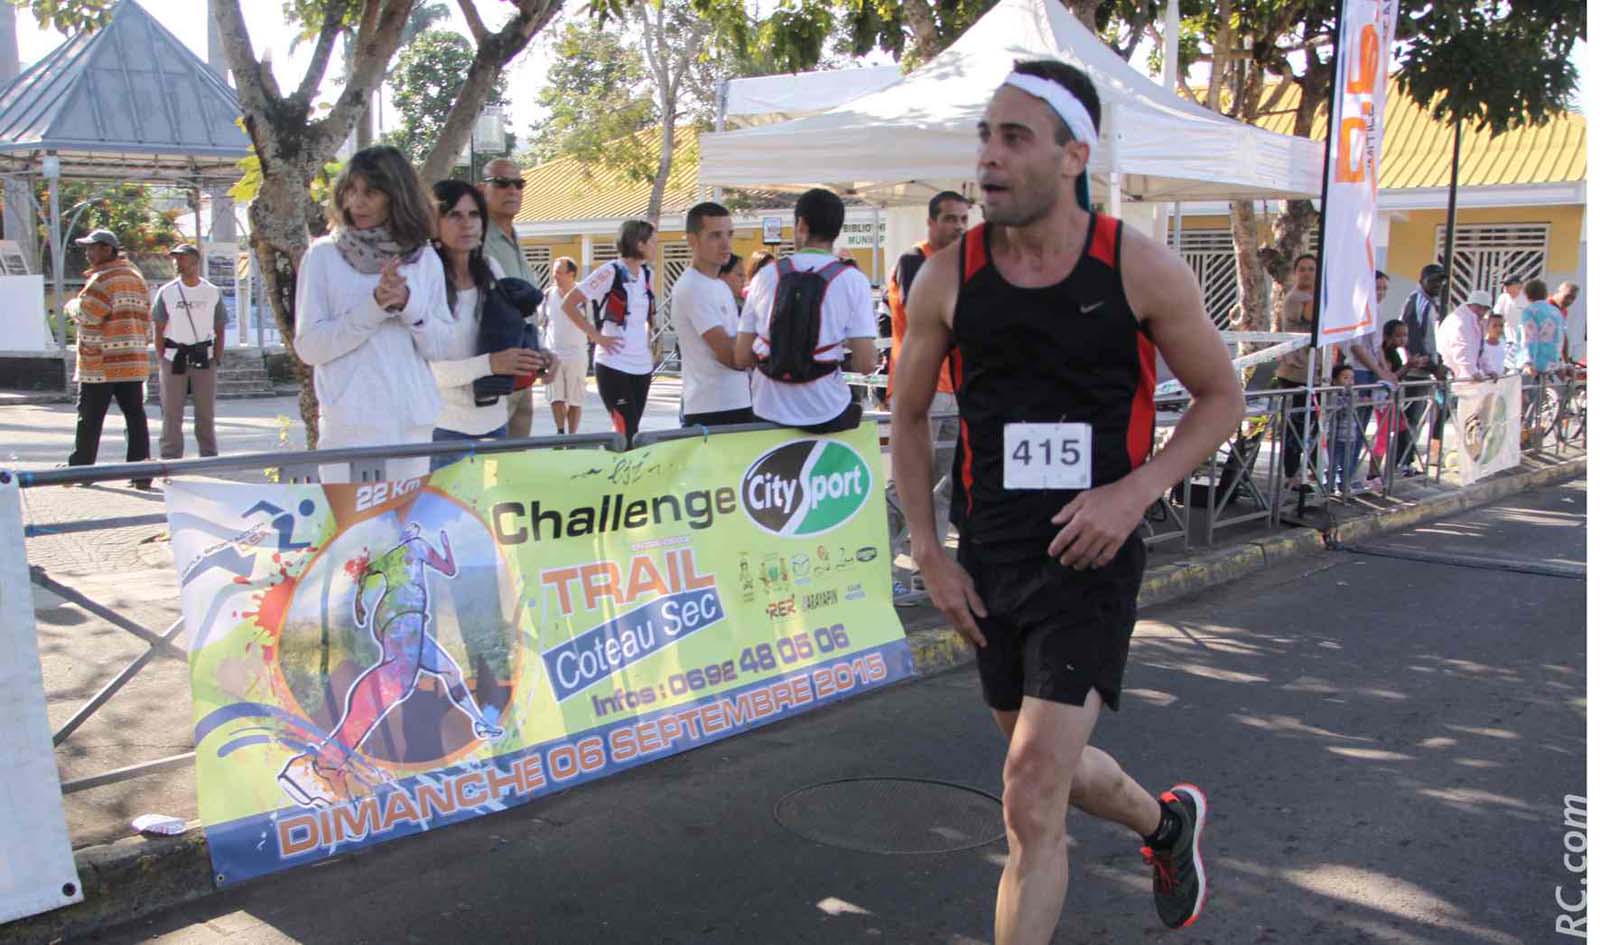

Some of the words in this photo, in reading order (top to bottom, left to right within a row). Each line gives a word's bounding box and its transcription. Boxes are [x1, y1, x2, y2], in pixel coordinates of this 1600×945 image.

[1012, 438, 1081, 466] 415
[355, 482, 388, 512] 22
[491, 485, 737, 546] Challenge
[748, 472, 798, 514] City
[541, 548, 717, 617] TRAIL
[556, 619, 656, 689] Coteau
[661, 593, 717, 636] Sec
[591, 687, 657, 717] Infos
[668, 659, 739, 697] 0692
[739, 642, 777, 674] 48
[777, 632, 815, 665] 05
[814, 623, 850, 652] 06
[276, 752, 548, 859] DIMANCHE
[548, 737, 607, 783] 06
[608, 674, 812, 763] SEPTEMBRE
[812, 651, 888, 700] 2015
